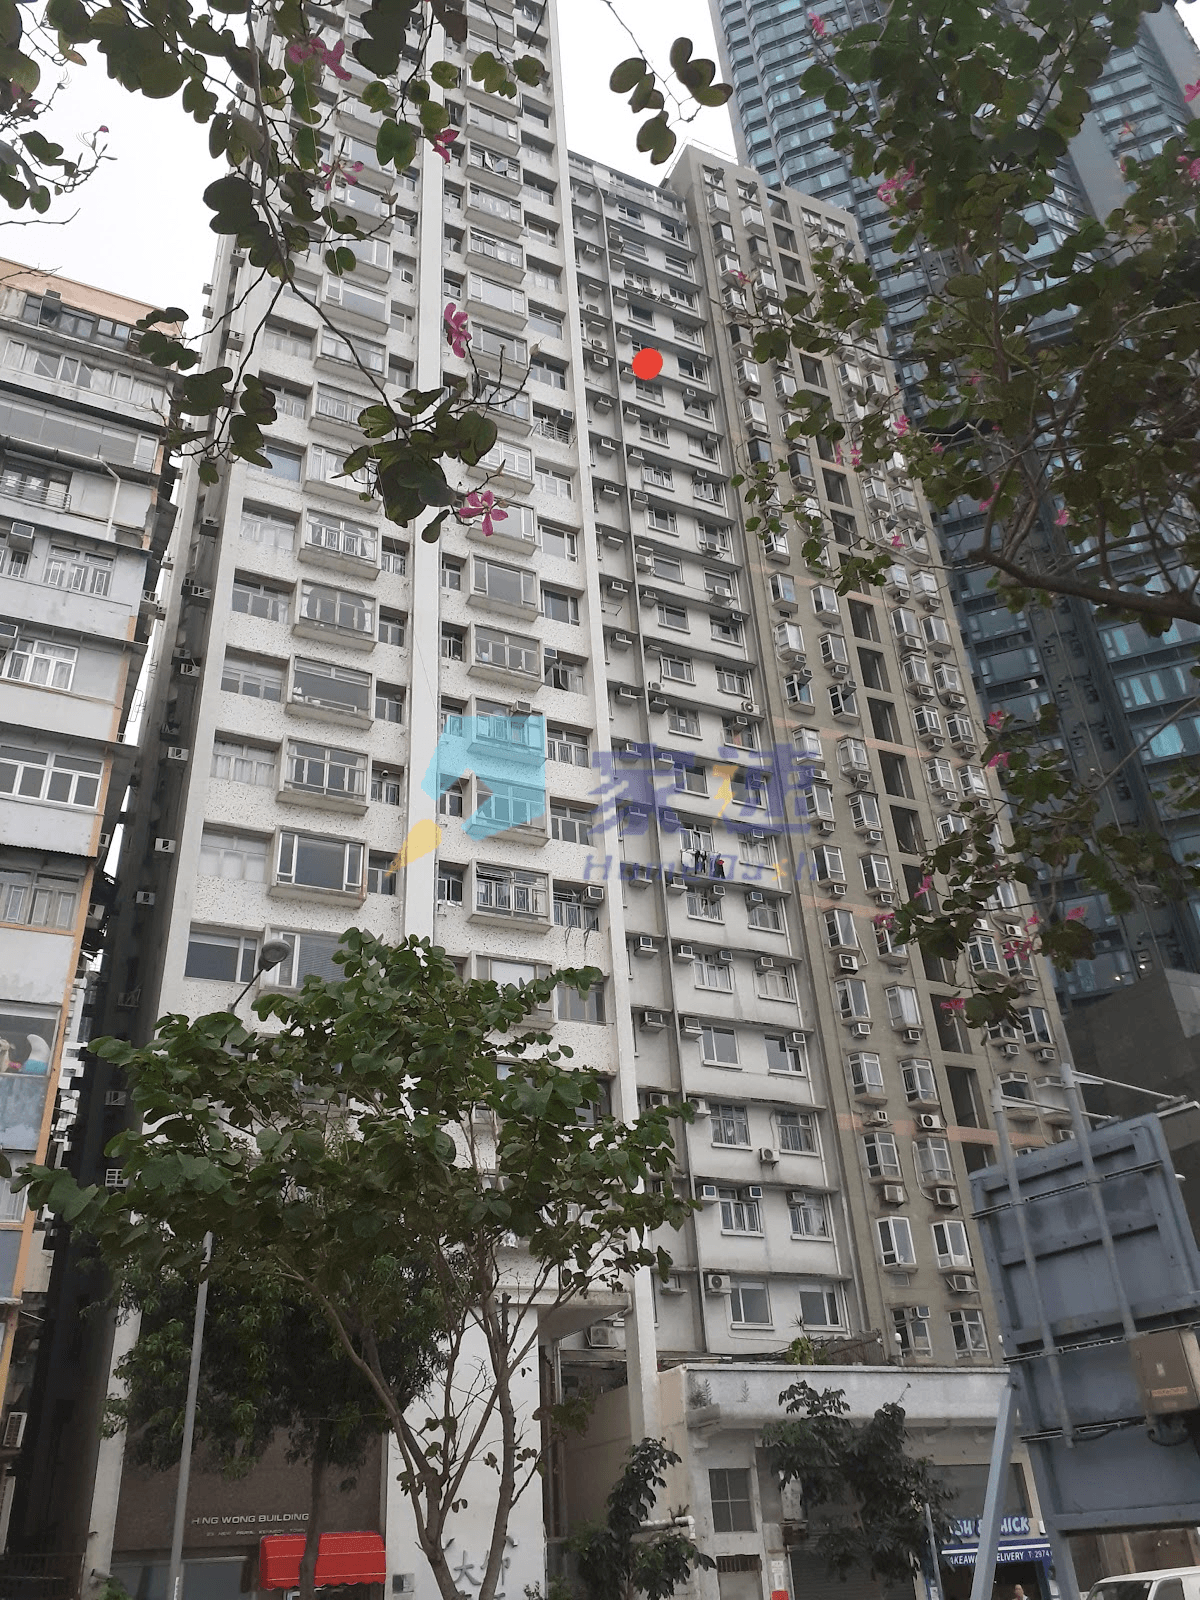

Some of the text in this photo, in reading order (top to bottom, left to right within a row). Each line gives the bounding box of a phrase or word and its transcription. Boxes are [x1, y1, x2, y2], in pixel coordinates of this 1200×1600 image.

[221, 1515, 256, 1524] WONG
[258, 1513, 309, 1523] BUILDING
[999, 1516, 1030, 1533] HICK
[996, 1550, 1024, 1562] ELIVERY
